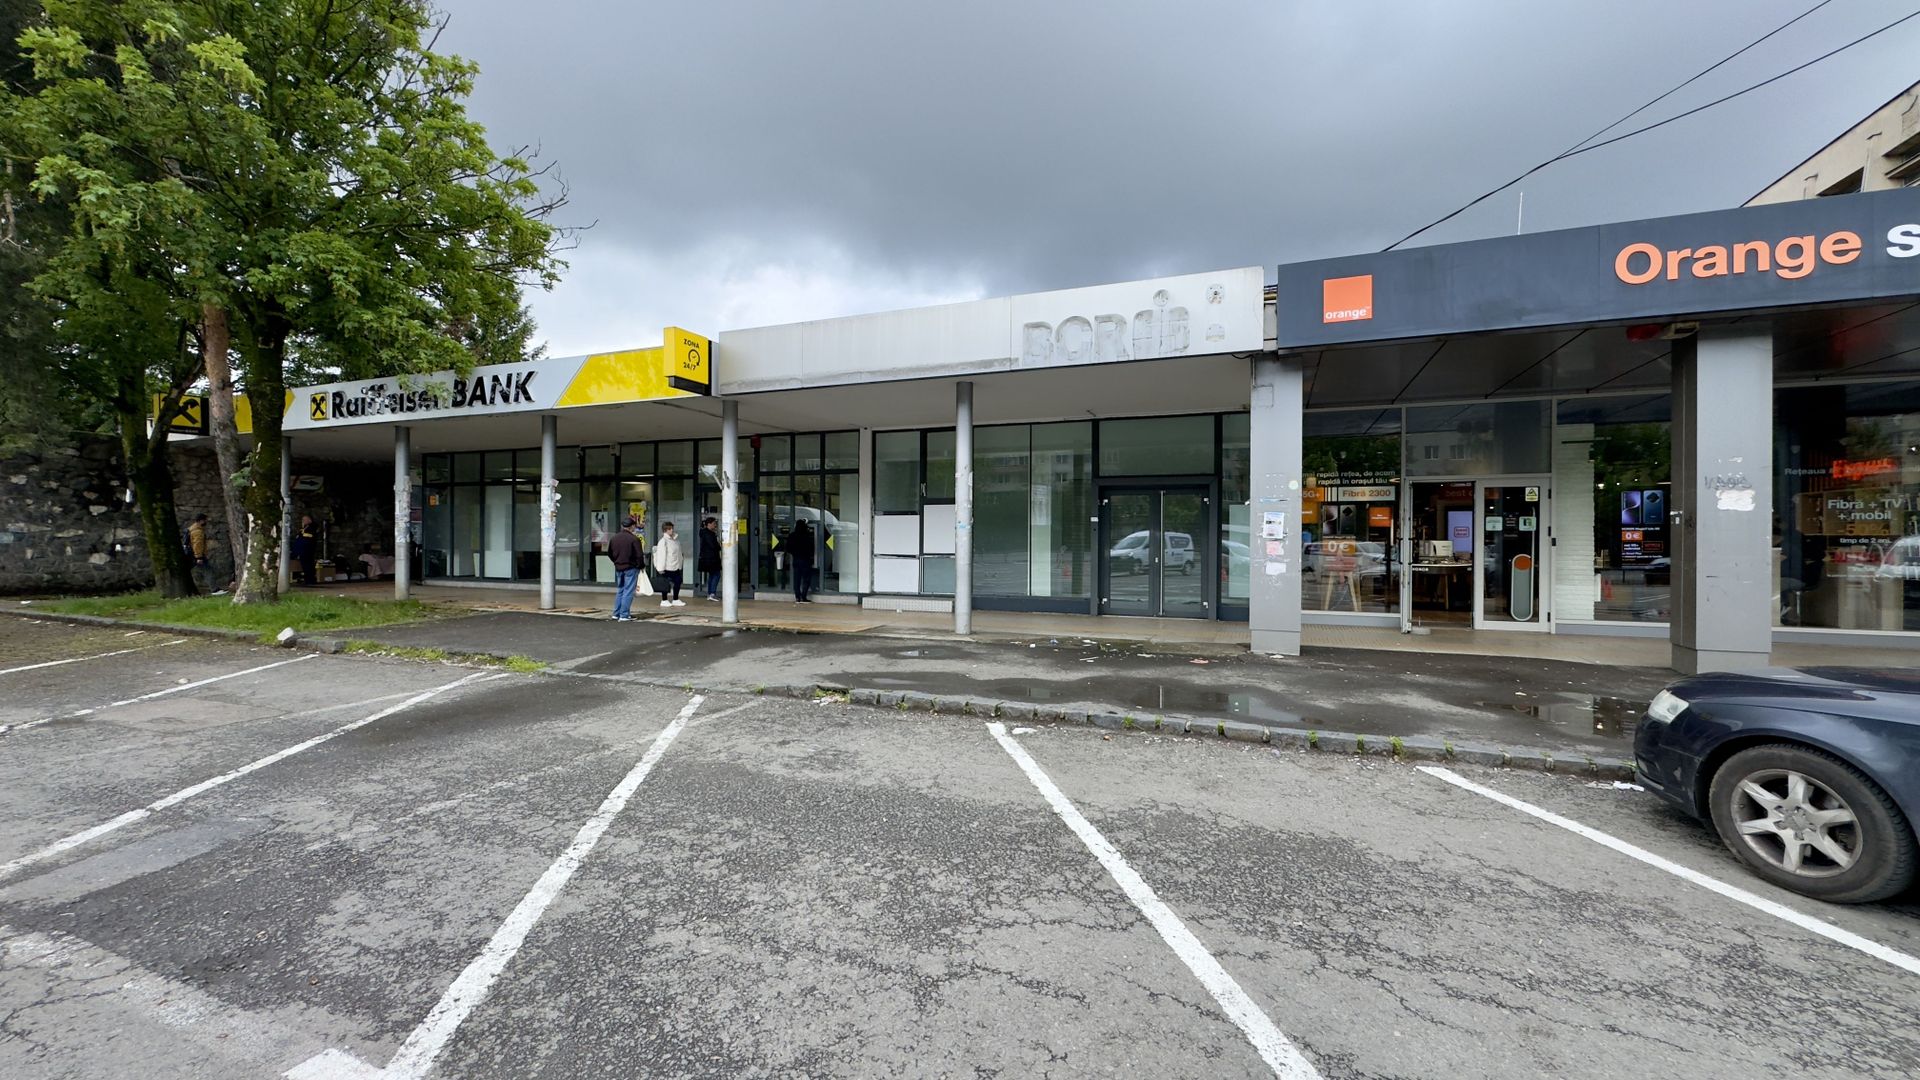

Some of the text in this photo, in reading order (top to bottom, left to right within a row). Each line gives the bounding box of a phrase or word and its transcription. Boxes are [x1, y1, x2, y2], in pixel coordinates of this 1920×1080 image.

[1614, 230, 1862, 285] Orange
[1325, 308, 1367, 319] orange
[683, 338, 700, 348] ZONA
[683, 361, 697, 371] 24/7
[451, 370, 536, 407] BANK
[1784, 468, 1826, 476] Rețeaua
[1368, 489, 1391, 497] 2300
[1883, 499, 1903, 508] TV
[1851, 510, 1891, 519] mobil
